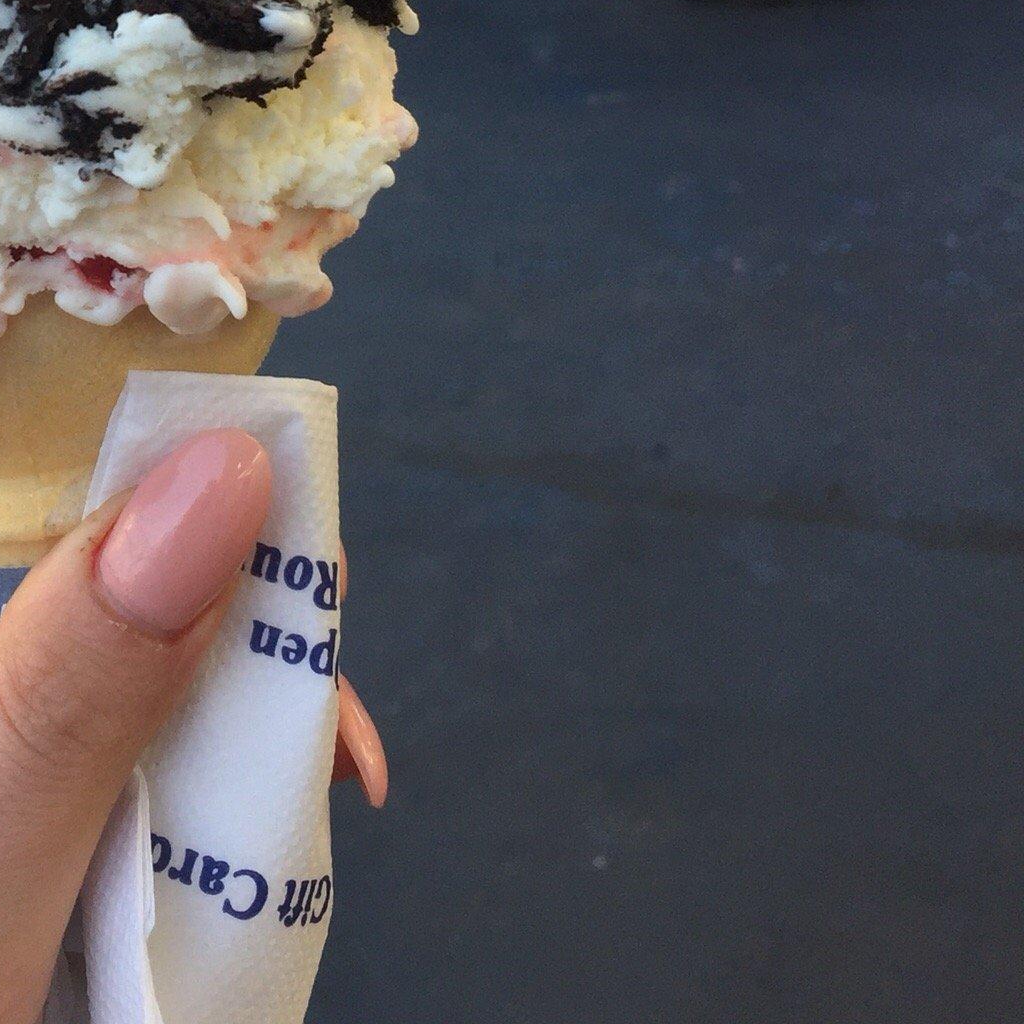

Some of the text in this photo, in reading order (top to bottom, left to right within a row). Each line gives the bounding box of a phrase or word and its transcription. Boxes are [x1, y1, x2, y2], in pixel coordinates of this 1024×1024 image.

[241, 541, 338, 611] Rou
[249, 619, 339, 691] pen
[277, 874, 332, 927] Gift
